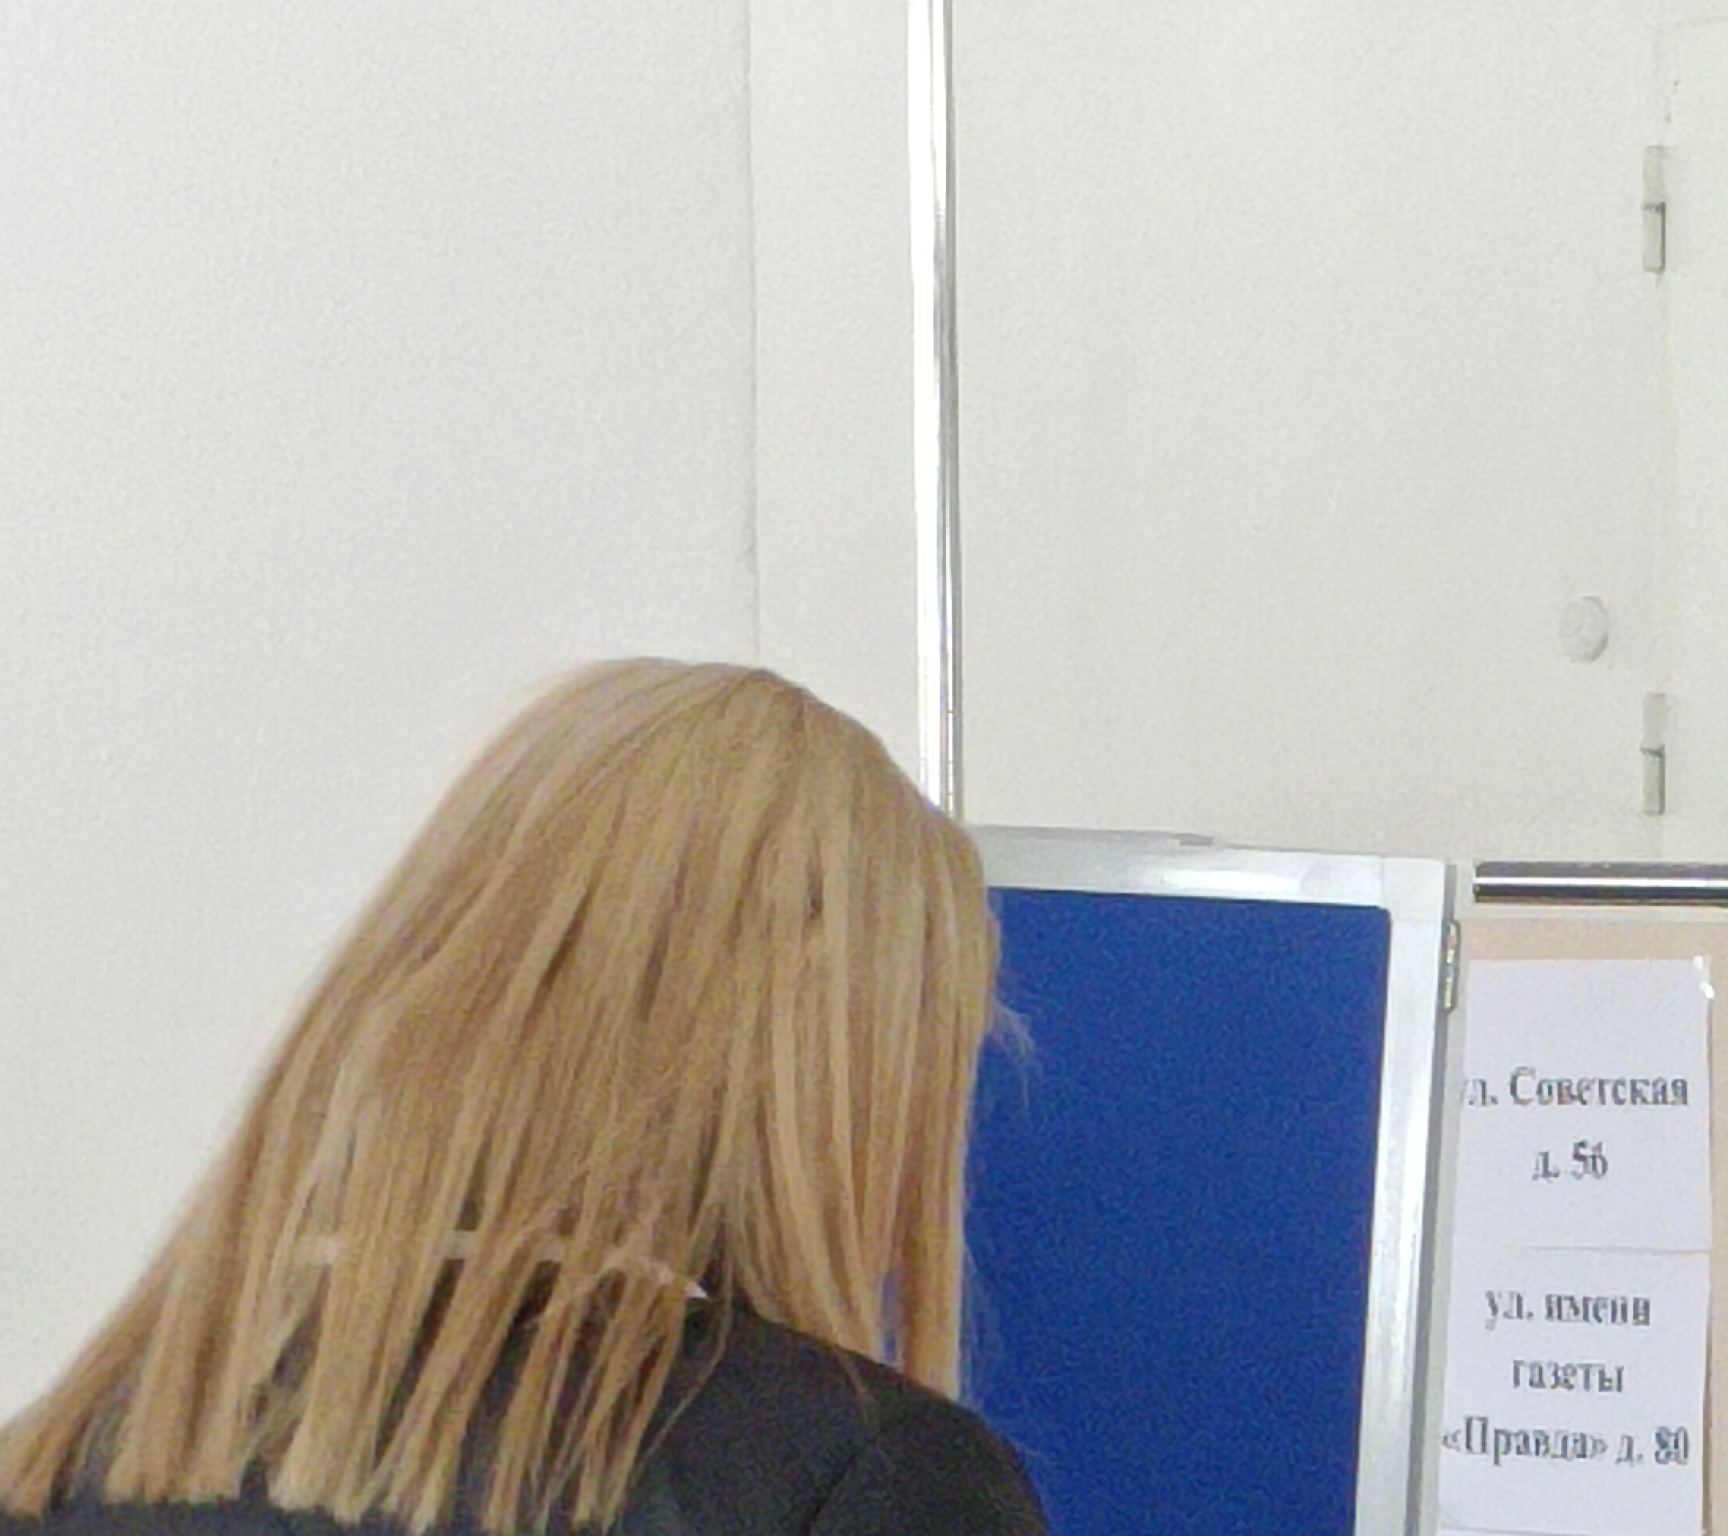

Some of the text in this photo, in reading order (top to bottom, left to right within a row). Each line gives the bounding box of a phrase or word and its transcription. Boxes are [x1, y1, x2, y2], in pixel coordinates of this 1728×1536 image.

[1463, 1066, 1690, 1106] л. Советская
[1532, 1151, 1561, 1183] д.
[1484, 1290, 1650, 1331] ул. имени
[1512, 1359, 1625, 1393] газеты
[1442, 1415, 1609, 1467] «Правда»
[1614, 1433, 1644, 1467] д.
